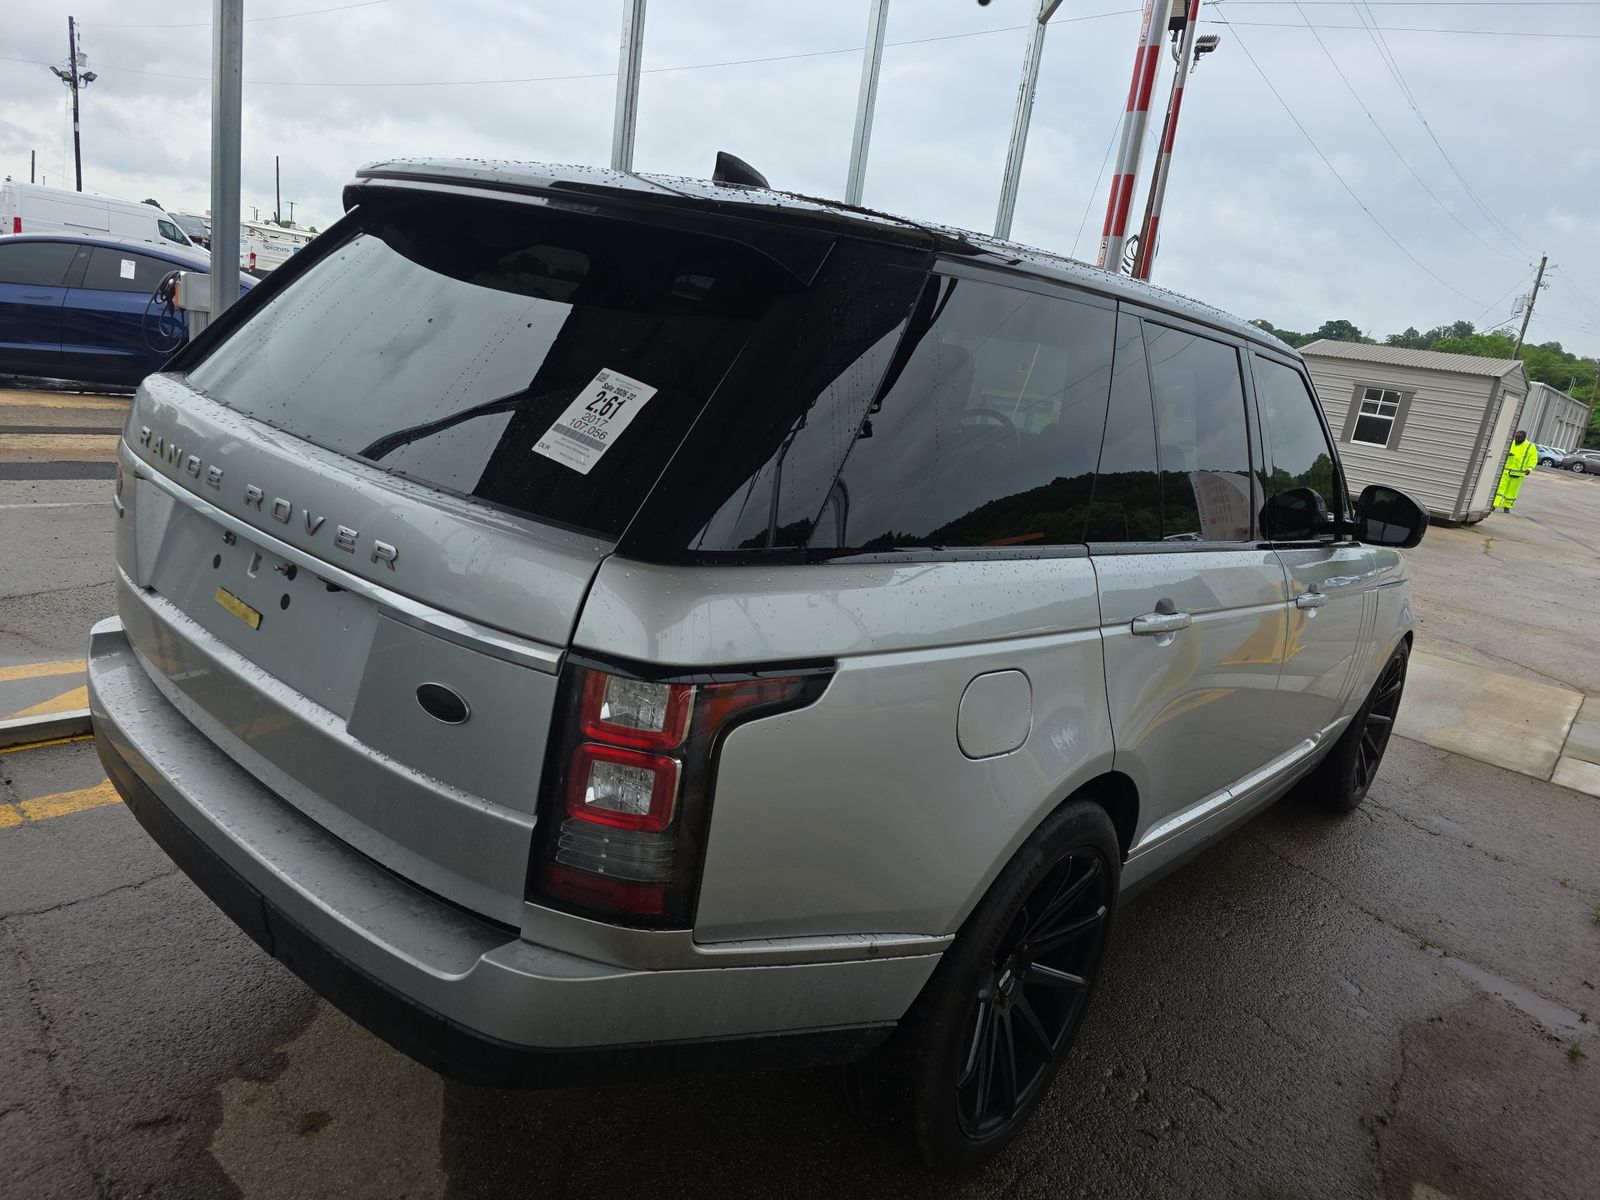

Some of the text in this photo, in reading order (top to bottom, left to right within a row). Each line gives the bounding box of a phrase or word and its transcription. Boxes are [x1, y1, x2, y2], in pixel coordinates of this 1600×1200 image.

[602, 382, 614, 391] Sale
[585, 391, 627, 420] 2:61
[581, 412, 609, 427] 2017
[538, 441, 551, 450] DLR
[139, 425, 400, 572] RANGE ROVER
